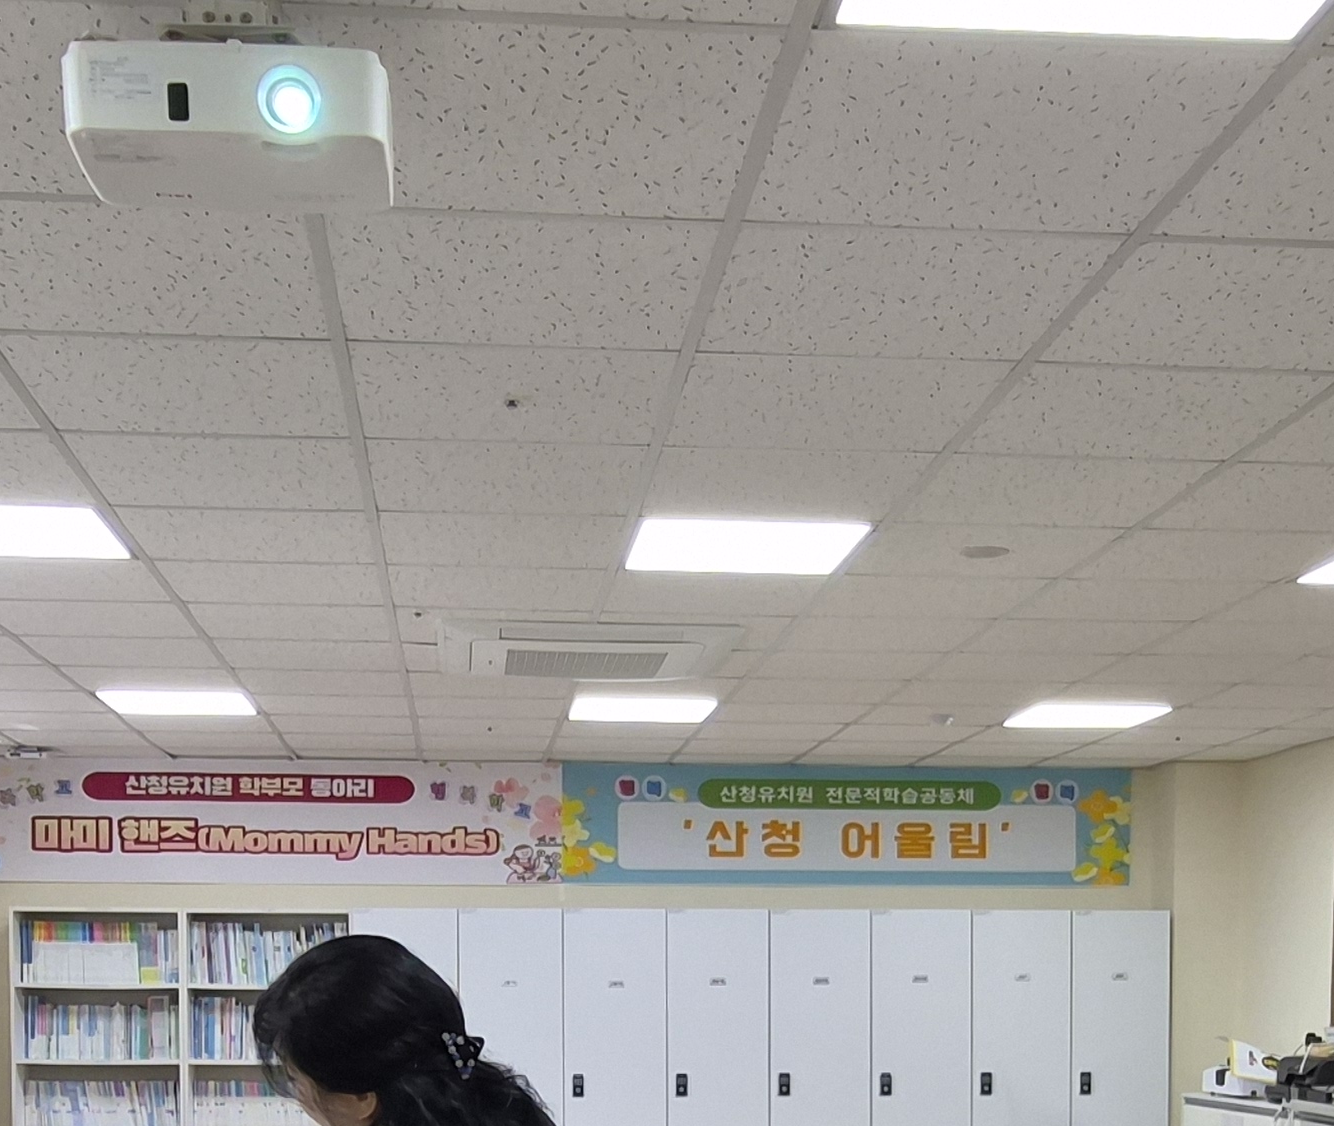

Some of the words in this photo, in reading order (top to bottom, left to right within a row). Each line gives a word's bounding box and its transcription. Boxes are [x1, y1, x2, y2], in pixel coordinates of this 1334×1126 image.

[124, 775, 233, 796] 산청유치원
[238, 776, 304, 797] 학부모
[310, 777, 374, 798] 동아리
[719, 785, 815, 804] 산청유치원
[825, 786, 976, 805] 전문적학습공동체
[32, 816, 113, 852] 마미
[366, 827, 503, 857] Hands)
